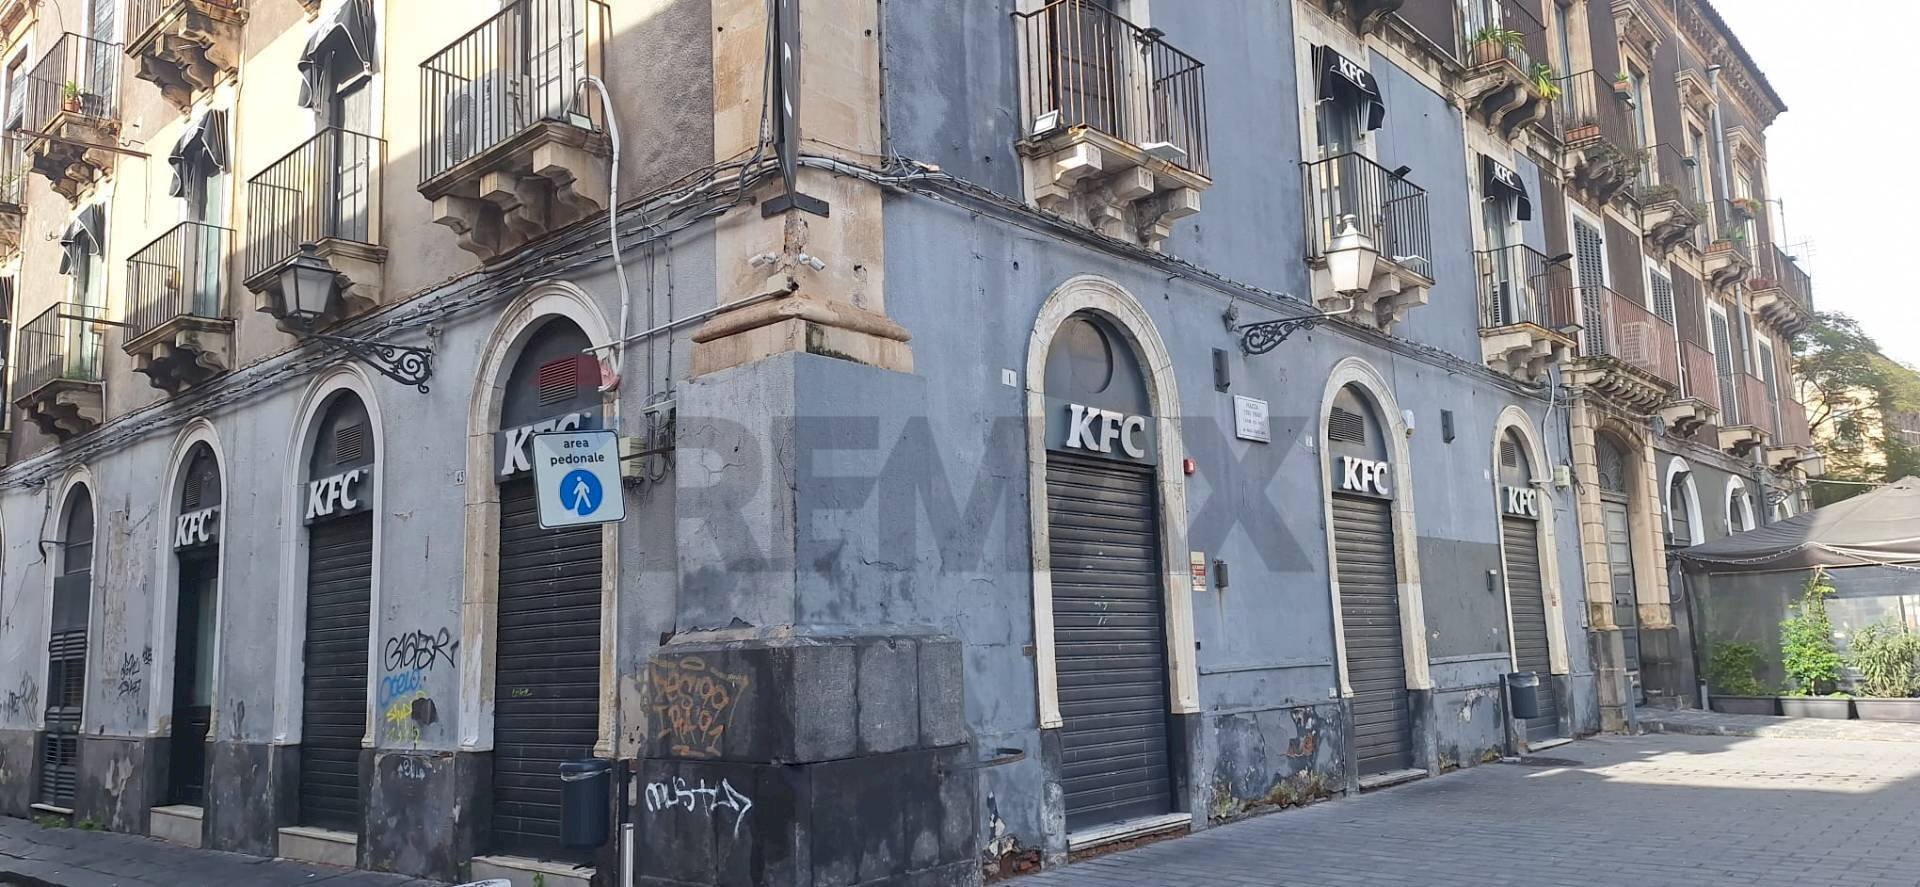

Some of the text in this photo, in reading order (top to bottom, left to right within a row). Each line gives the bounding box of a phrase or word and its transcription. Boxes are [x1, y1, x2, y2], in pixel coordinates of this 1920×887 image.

[1338, 55, 1366, 88] KFC
[1494, 161, 1515, 186] KFC
[563, 439, 590, 449] area
[1066, 403, 1145, 459] KFC
[550, 452, 605, 467] pedonale
[1342, 455, 1389, 495] KFC
[305, 469, 360, 519] KFC
[1508, 486, 1538, 517] KFC
[174, 508, 212, 548] KFC
